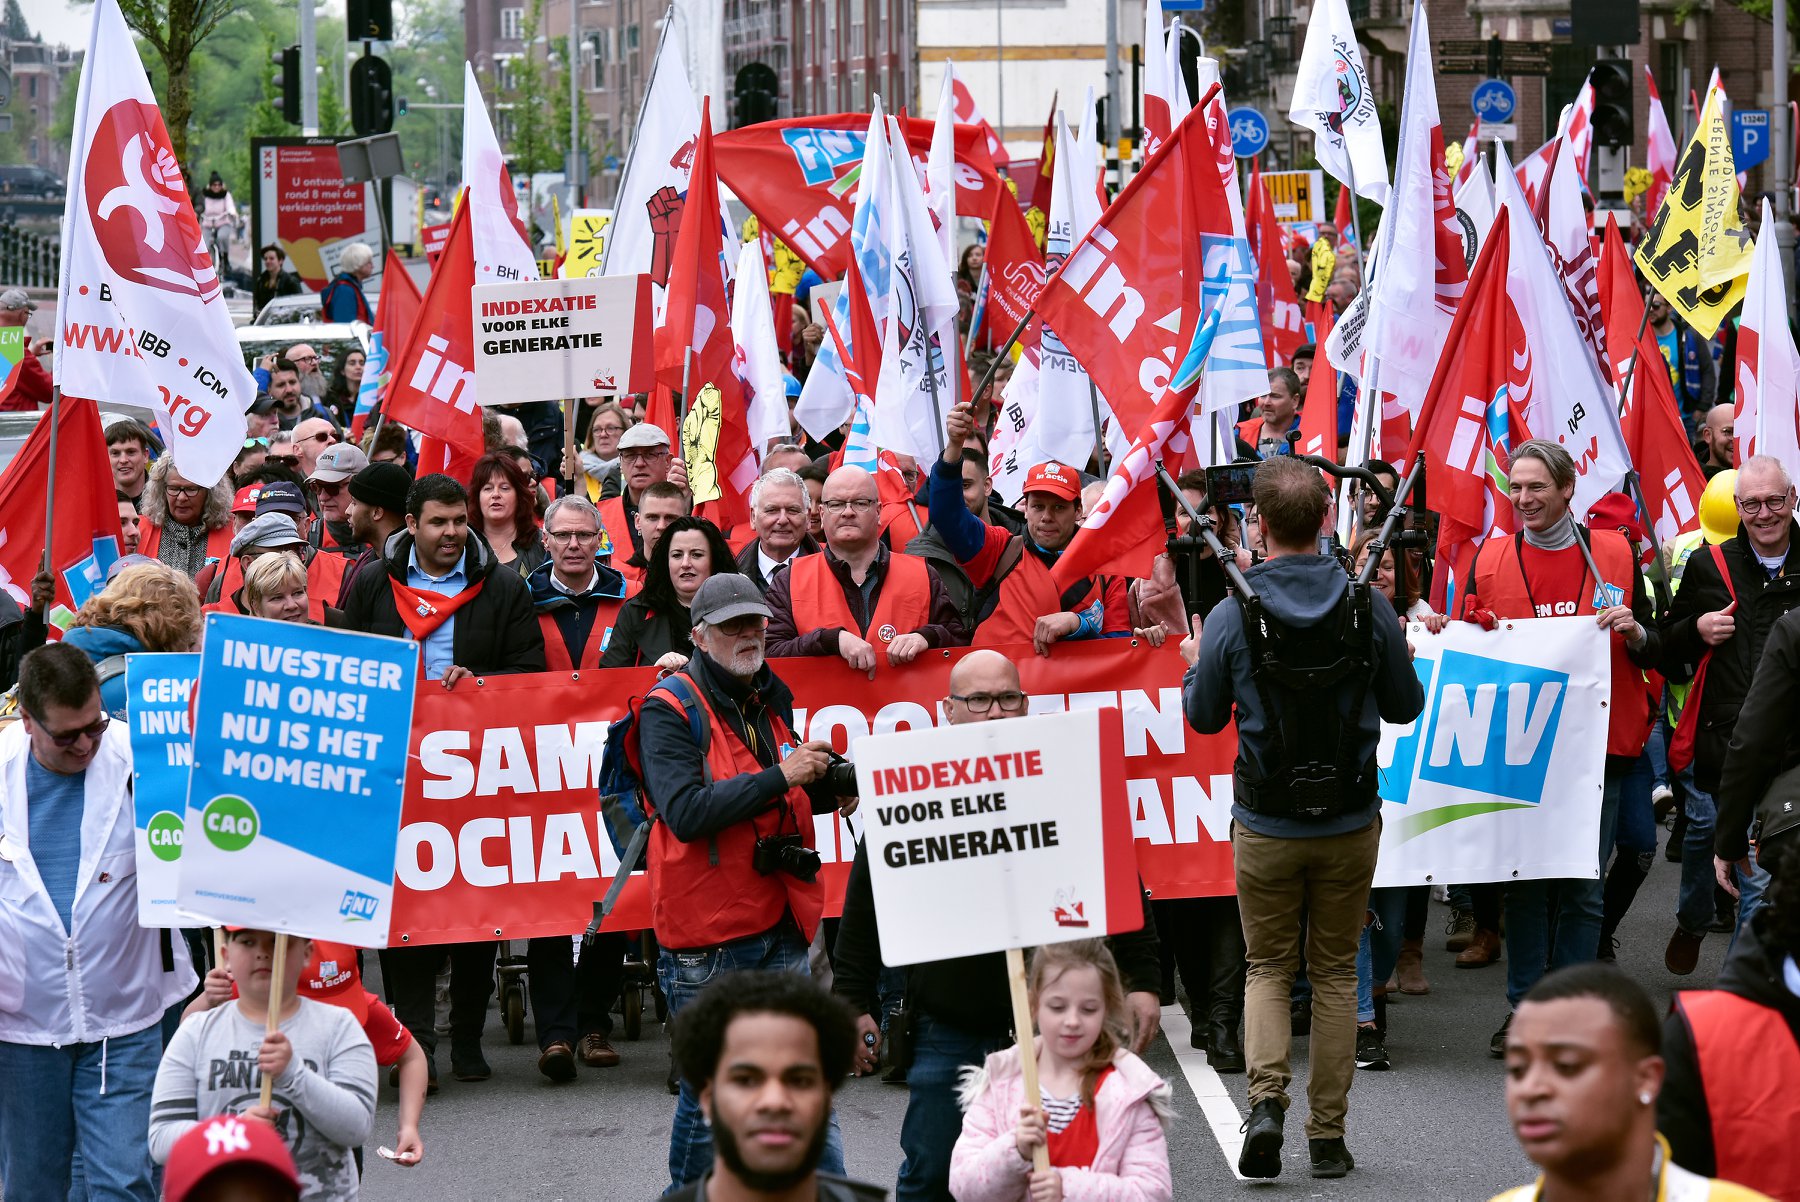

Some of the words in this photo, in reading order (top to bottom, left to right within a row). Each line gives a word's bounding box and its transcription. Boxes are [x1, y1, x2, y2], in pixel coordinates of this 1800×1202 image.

[1743, 114, 1765, 127] 13240
[1743, 131, 1759, 158] P
[285, 189, 310, 199] rond
[312, 190, 319, 199] 8
[321, 189, 341, 199] mei
[343, 190, 357, 199] de
[291, 178, 301, 187] U
[303, 178, 345, 189] ontvang
[279, 201, 363, 214] verkiezingskrant
[299, 216, 318, 226] per
[320, 216, 343, 226] post
[497, 265, 519, 280] BHI
[481, 295, 597, 317] INDEXATIE
[482, 320, 527, 334] VOOR
[531, 316, 570, 331] ELKE
[137, 330, 171, 358] IBB
[483, 332, 603, 357] GENERATIE
[193, 365, 229, 399] ICM
[1006, 402, 1025, 433] IBB
[1555, 601, 1576, 614] GO
[222, 640, 403, 690] INVESTEER
[244, 679, 280, 709] IN
[288, 687, 368, 722] ONS!
[220, 712, 271, 748] NU
[278, 720, 310, 753] IS
[317, 727, 383, 761] HET
[222, 748, 372, 796] MOMENT.
[420, 720, 612, 800] SAM
[872, 750, 1044, 797] INDEXATIE
[876, 800, 945, 827] VOOR
[950, 792, 1008, 818] ELKE
[207, 813, 254, 836] CAO
[883, 820, 1061, 869] GENERATIE
[342, 892, 378, 918] FNV
[310, 979, 323, 989] in
[325, 970, 352, 988] actie
